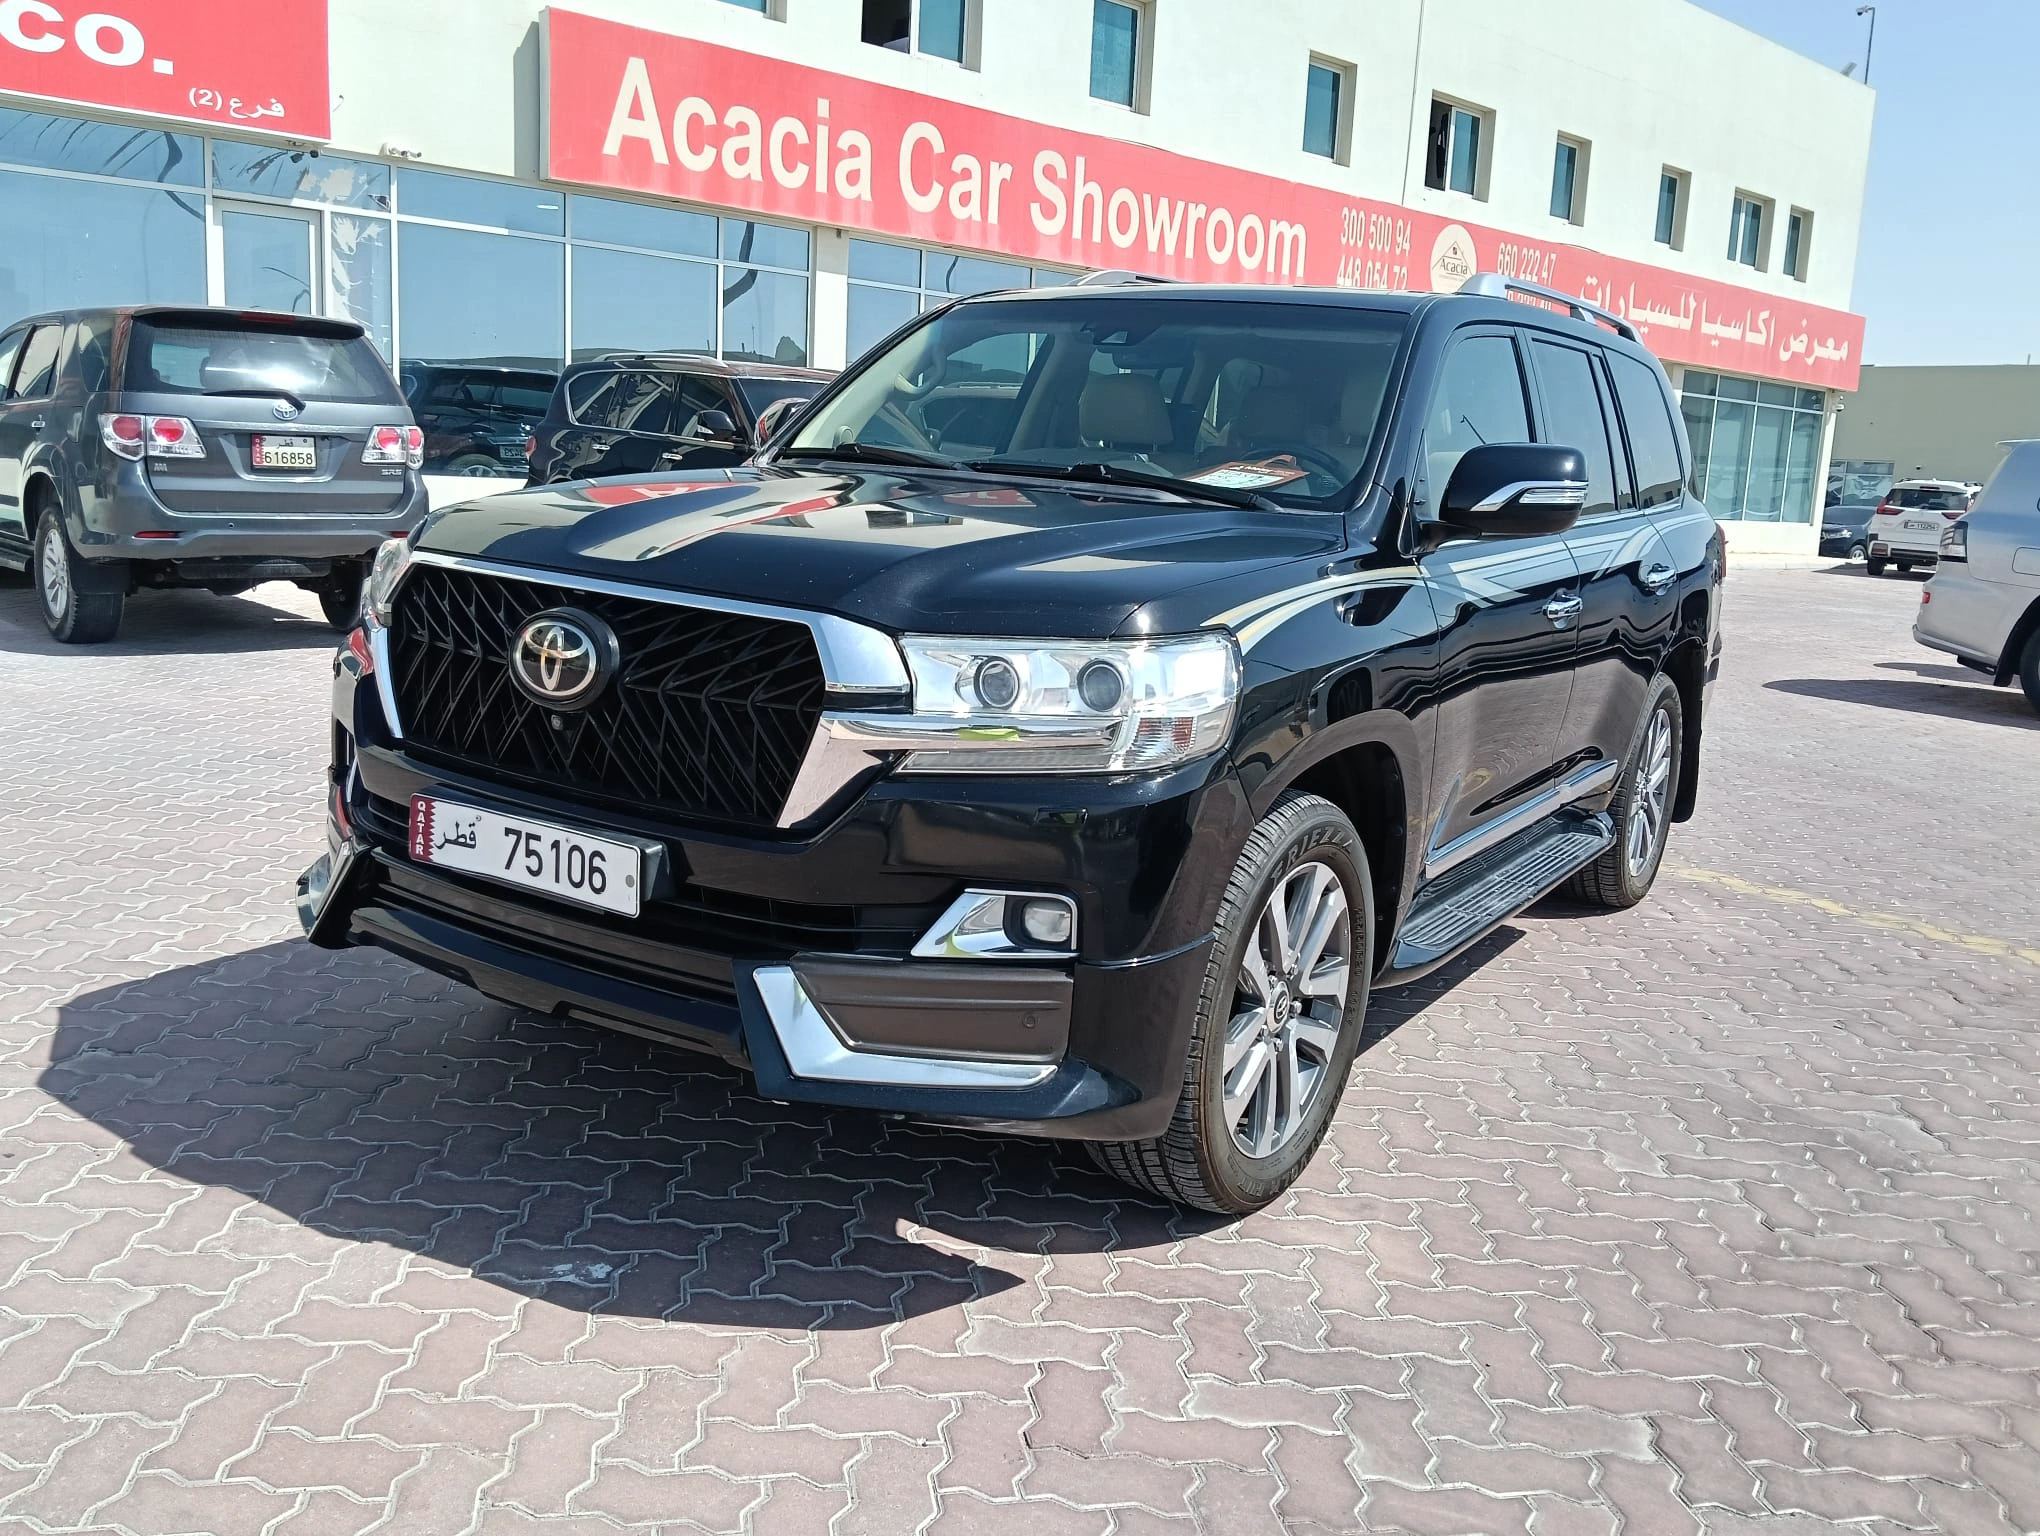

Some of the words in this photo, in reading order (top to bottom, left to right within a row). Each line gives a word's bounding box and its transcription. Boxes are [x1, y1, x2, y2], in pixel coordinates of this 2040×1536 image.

[189, 88, 222, 111] (2)
[230, 98, 285, 119] فرع
[602, 56, 872, 202] Acacia
[899, 121, 1014, 225] Car
[1030, 149, 1307, 278] Showroom
[1341, 206, 1366, 249] 300
[1369, 213, 1393, 253] 500
[1395, 218, 1411, 257] 94
[1336, 255, 1362, 287] 448
[1365, 260, 1389, 289] 054
[1393, 265, 1408, 290] 72
[1440, 258, 1468, 275] Acacia
[1498, 242, 1518, 277] 660
[1520, 247, 1541, 283] 222
[1541, 251, 1557, 288] 47
[1779, 318, 1849, 366] معرض
[264, 451, 313, 465] 616858
[416, 801, 426, 855] QATAR
[434, 821, 477, 850] قطر
[504, 826, 607, 895] 75106
